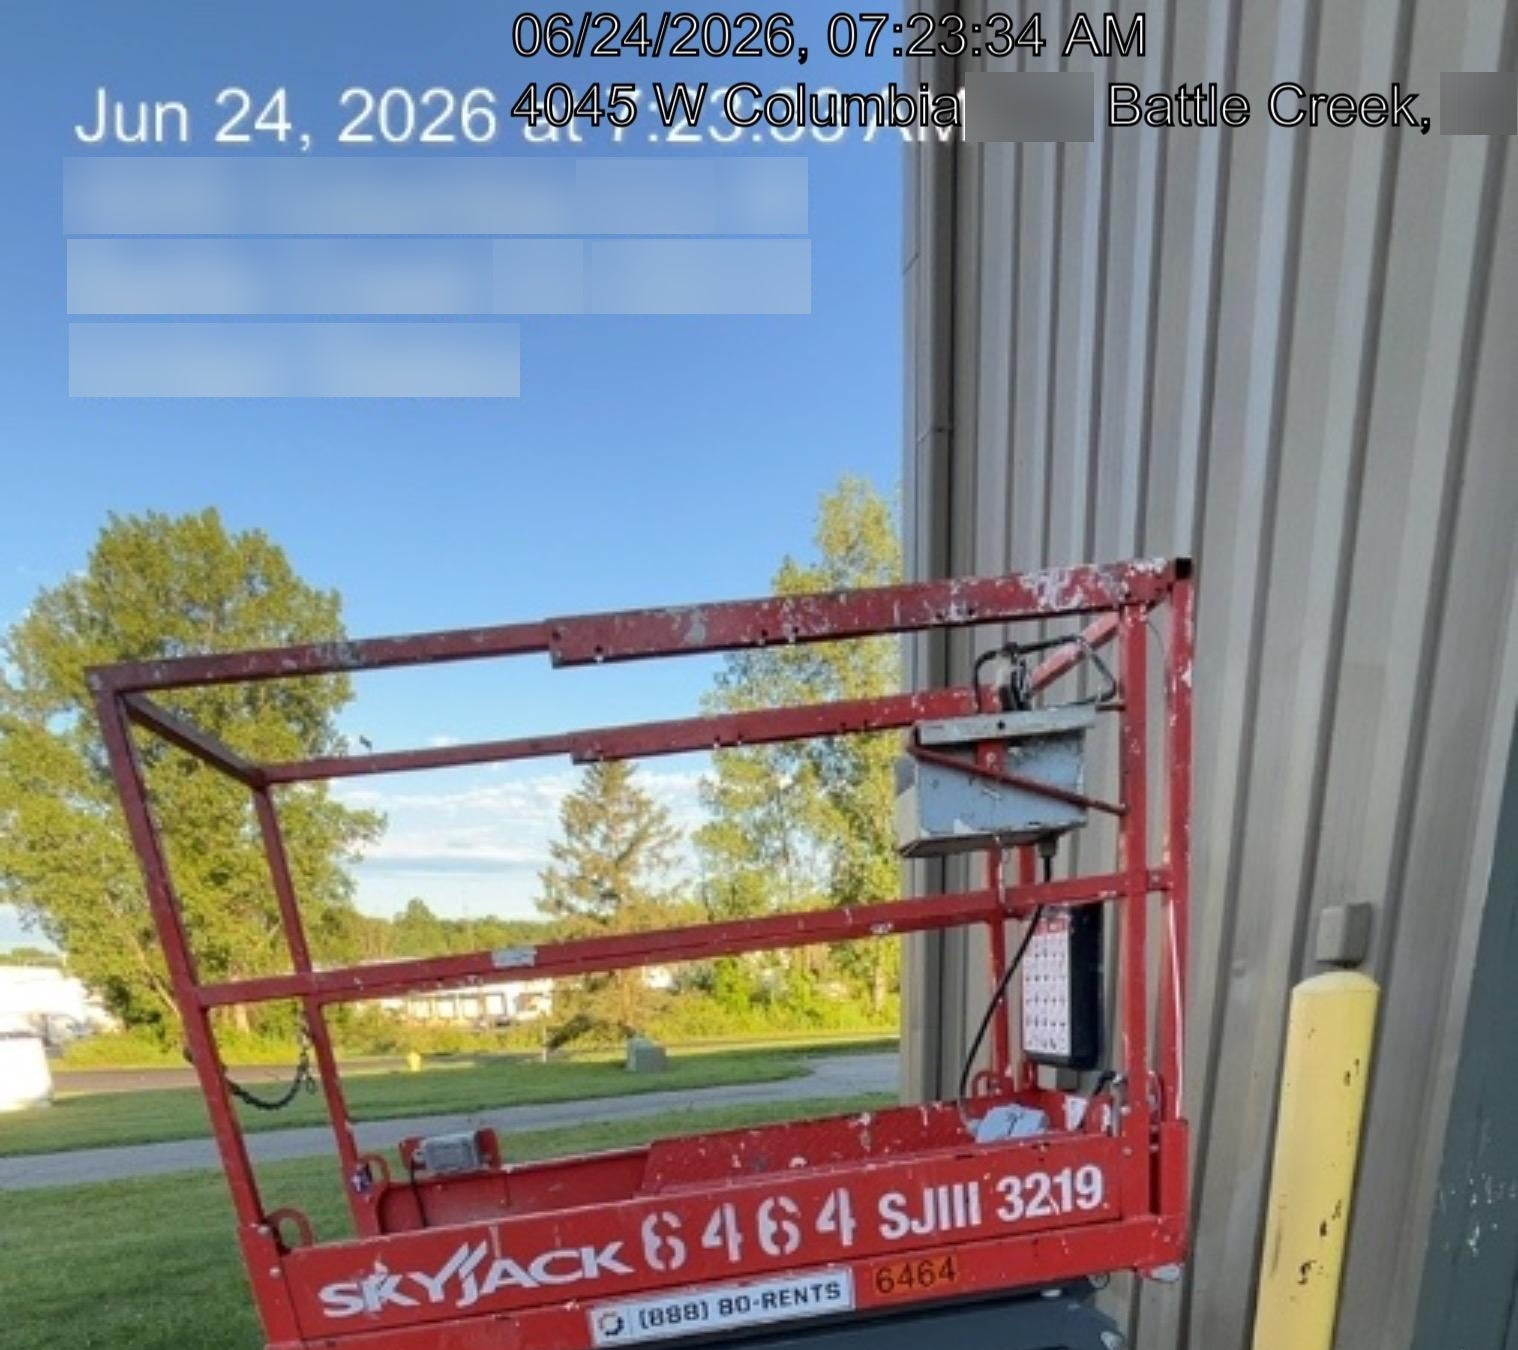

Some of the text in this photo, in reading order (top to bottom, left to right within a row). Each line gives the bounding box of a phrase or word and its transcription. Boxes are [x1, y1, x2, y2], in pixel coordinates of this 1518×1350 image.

[996, 1163, 1103, 1222] 3219
[639, 1187, 857, 1271] 6464
[318, 1240, 633, 1319] SKYJACK
[874, 1255, 956, 1294] 6464
[639, 1281, 842, 1330] (888) 80-RENTS
